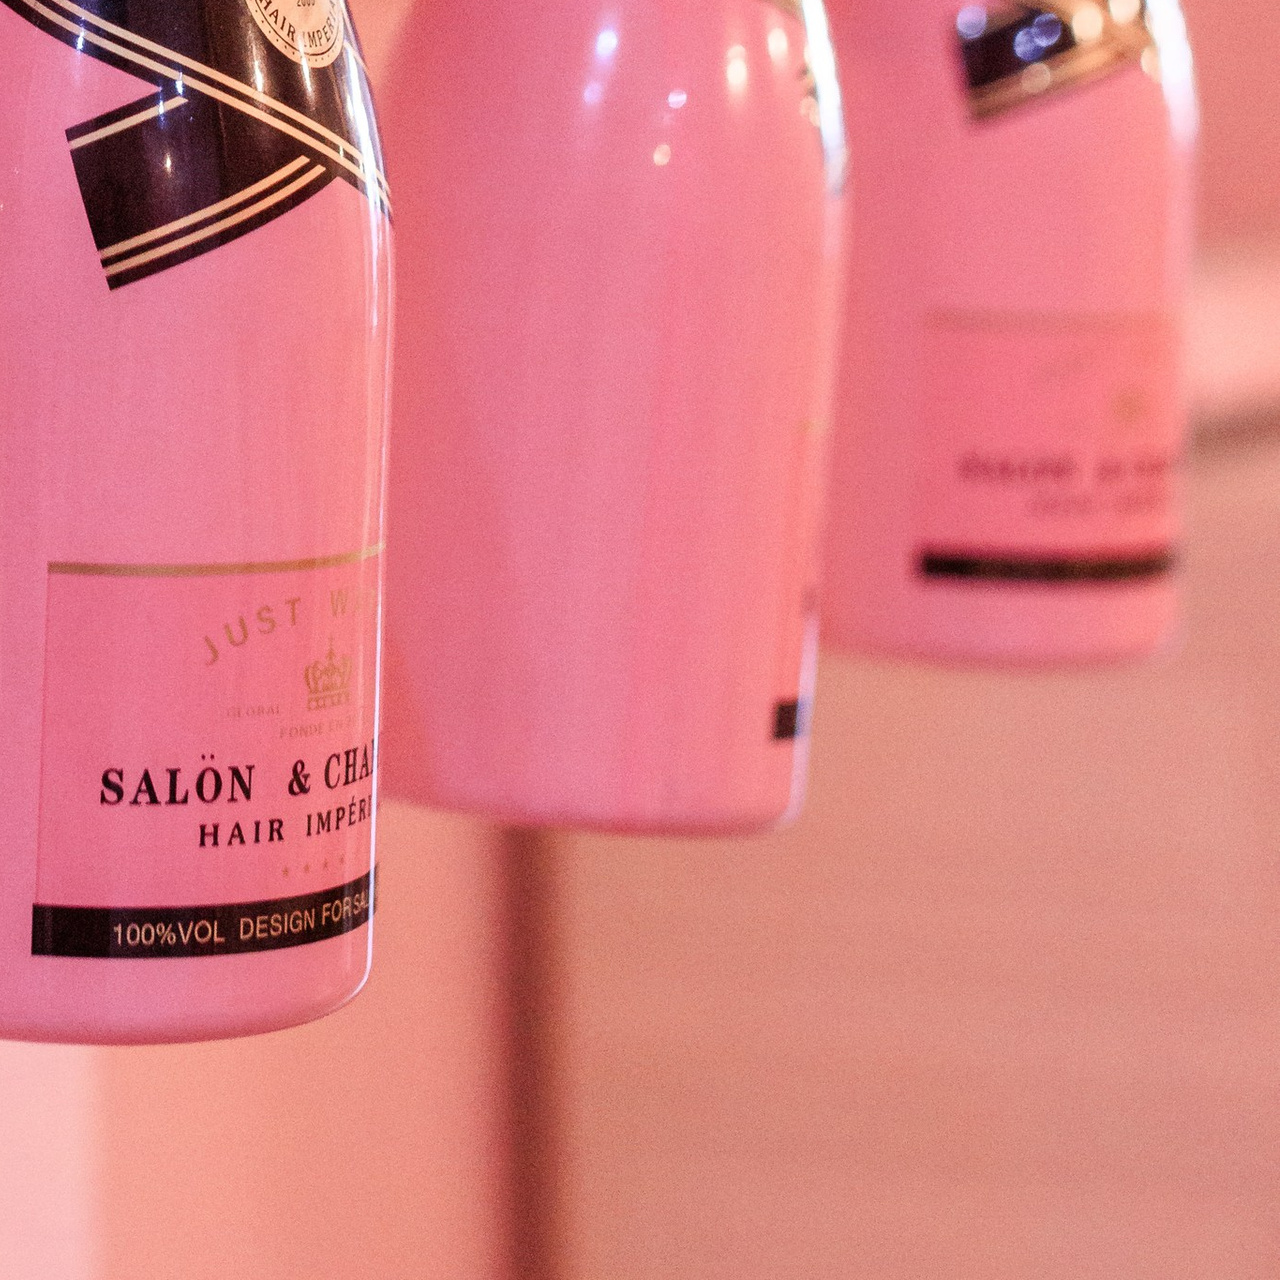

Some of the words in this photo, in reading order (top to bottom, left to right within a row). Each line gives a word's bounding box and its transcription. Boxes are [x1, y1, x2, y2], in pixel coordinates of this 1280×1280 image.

[204, 597, 303, 666] JUST
[100, 754, 256, 806] SALÖN
[288, 759, 310, 796] &
[199, 818, 284, 848] HAIR
[240, 908, 315, 941] DESIGN
